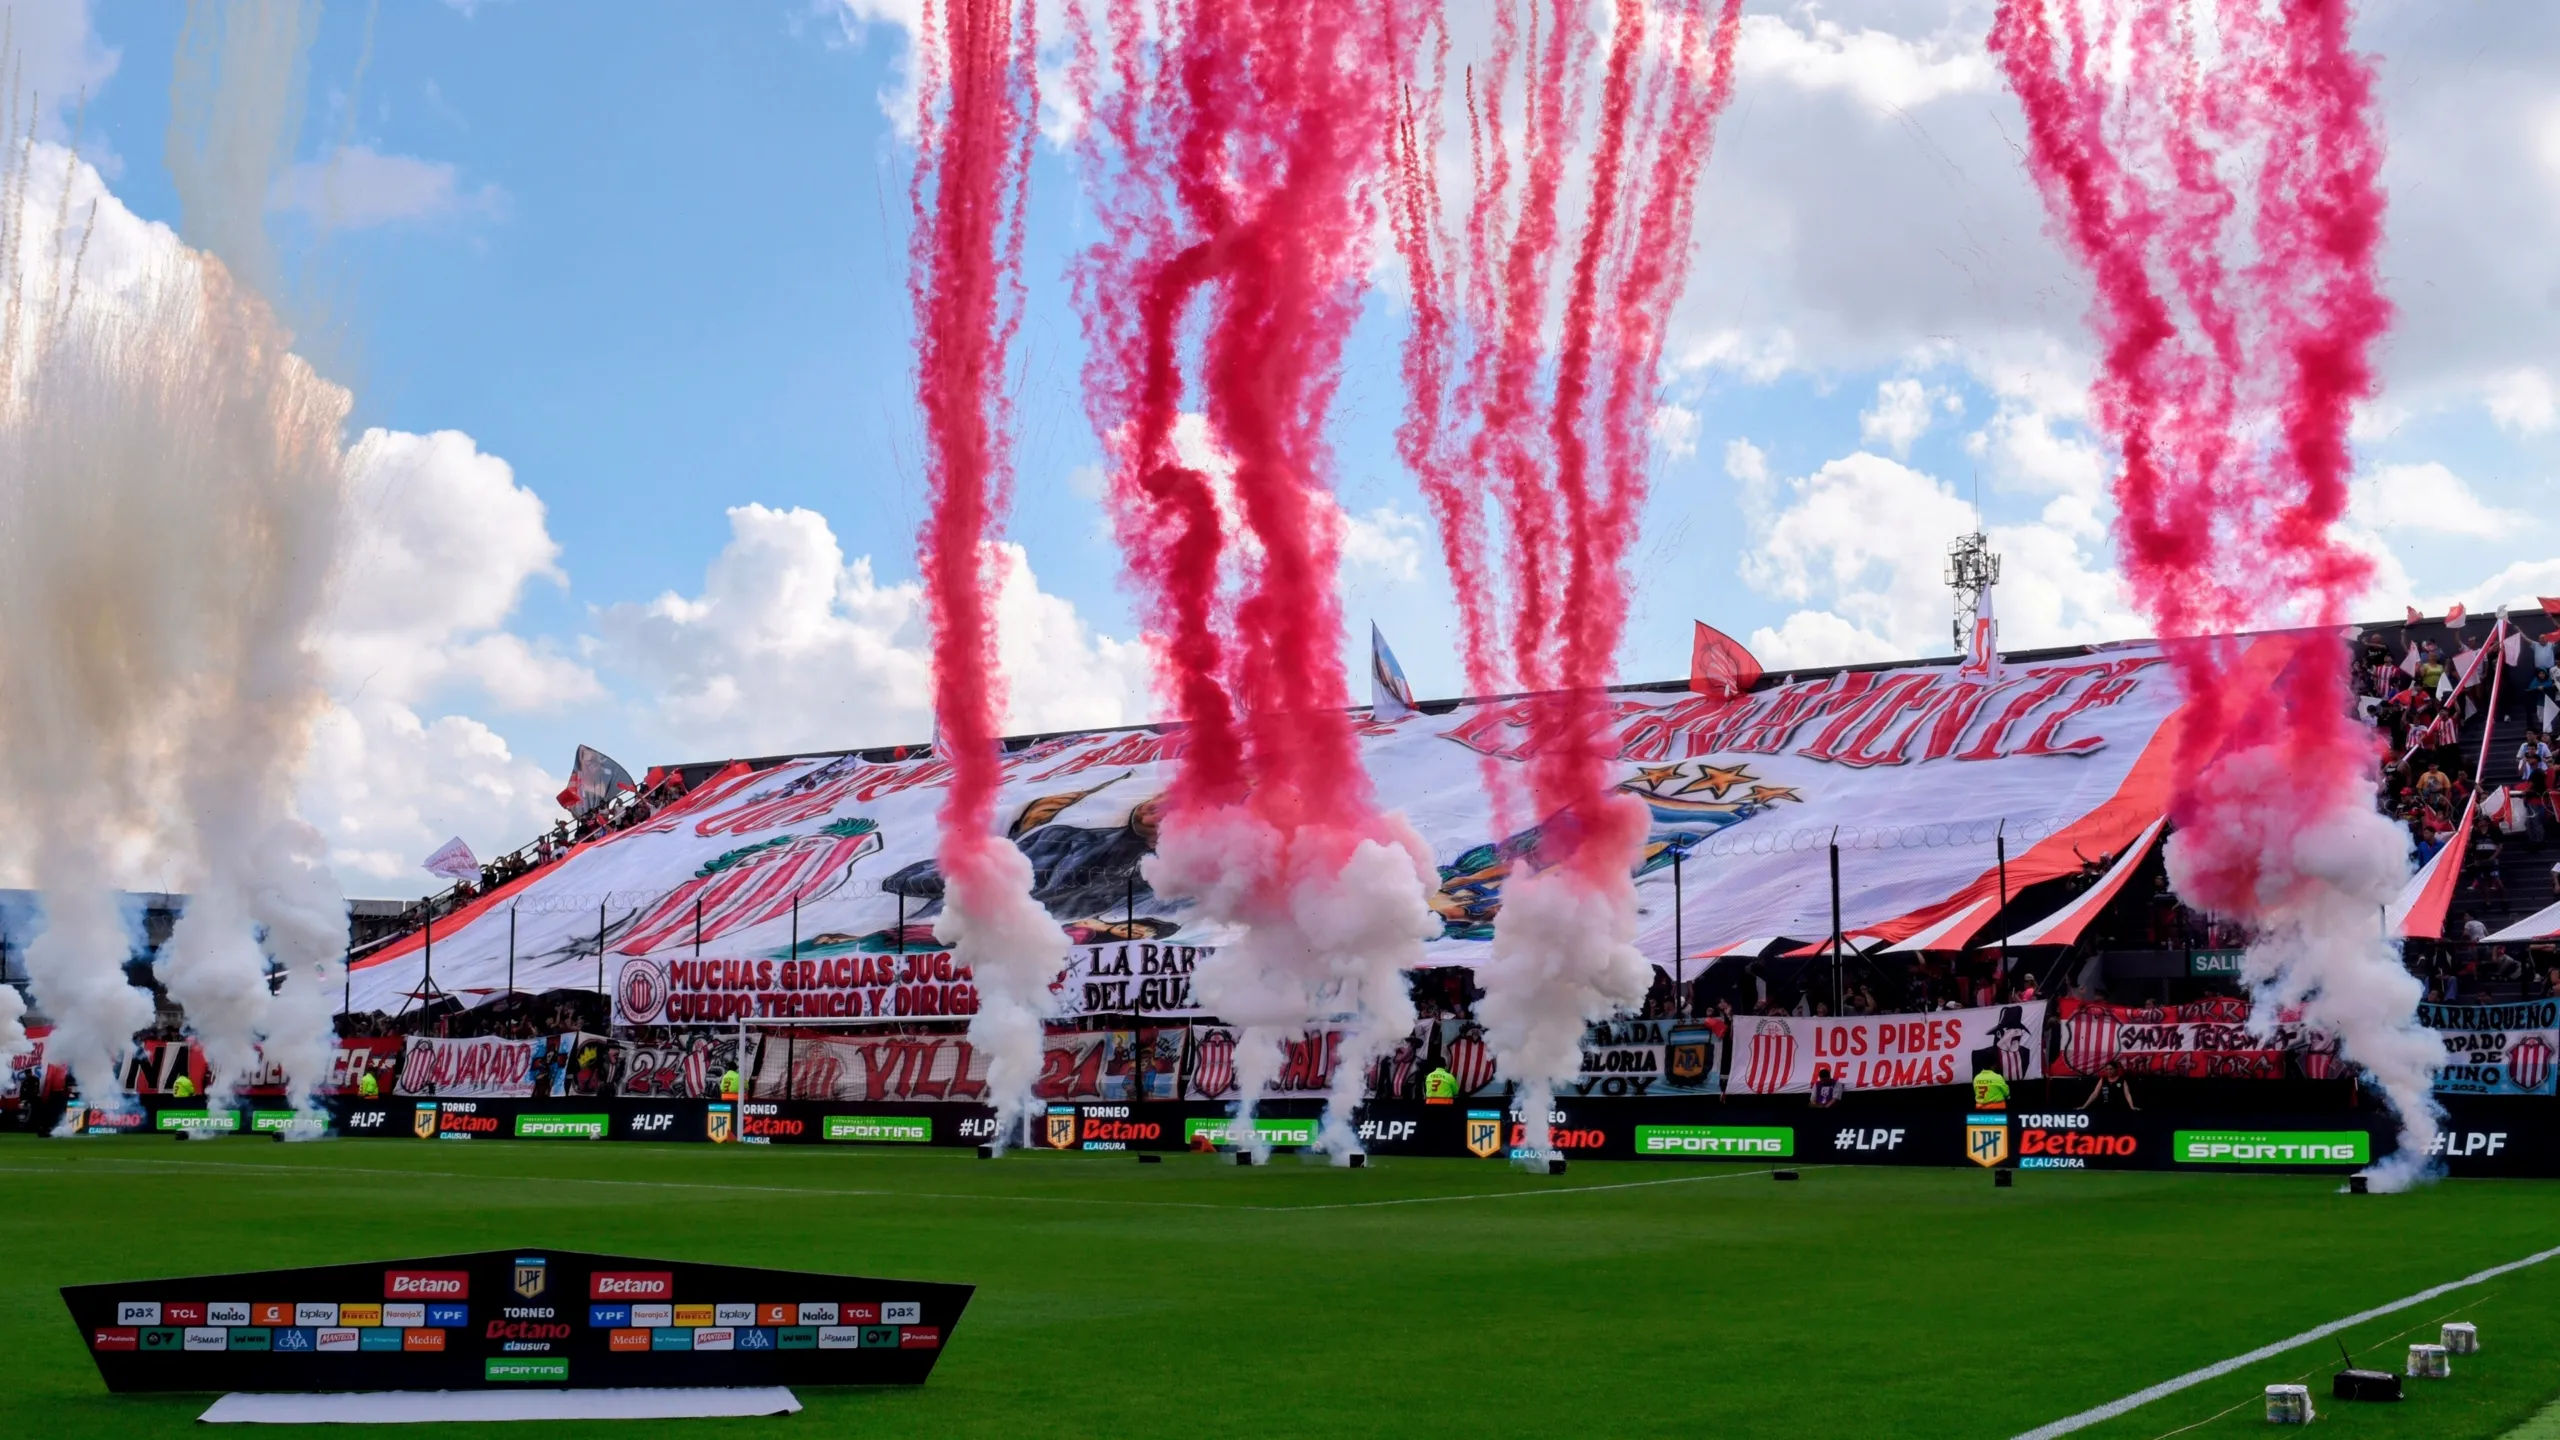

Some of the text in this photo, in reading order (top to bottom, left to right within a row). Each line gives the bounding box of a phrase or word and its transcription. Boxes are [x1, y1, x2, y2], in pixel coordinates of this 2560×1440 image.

[1087, 943, 1215, 976] LA BAR
[669, 951, 972, 991] MUCHAS GRACIAS JUGA
[1083, 981, 1135, 1012] DEL
[665, 993, 752, 1023] CUERPO
[757, 991, 863, 1019] TECNICO
[867, 988, 888, 1017] Y
[1815, 1019, 1962, 1057] LOS PIBES
[2120, 1024, 2184, 1051] SANTA
[2443, 1033, 2507, 1053] RPADO
[1580, 1049, 1657, 1073] GLORIA
[2470, 1052, 2503, 1064] DE
[430, 1043, 532, 1088] ALVARADO
[626, 1050, 681, 1094] 24
[855, 1039, 990, 1100] VILL
[1031, 1041, 1105, 1101] 21
[1855, 1054, 1955, 1089] LOMAS
[2434, 1065, 2500, 1085] TINO
[1576, 1075, 1657, 1096] VOY
[1977, 1086, 1988, 1099] 3
[442, 1103, 477, 1113] TORNEO
[743, 1104, 778, 1115] ORNEO
[1082, 1106, 1130, 1118] TORNEO
[89, 1109, 141, 1127] Betano
[162, 1118, 235, 1127] SPORTING
[256, 1119, 323, 1128] SPORNG
[349, 1112, 386, 1128] #LPF
[440, 1113, 498, 1132] Betano
[631, 1114, 674, 1131] #LPF
[1509, 1110, 1567, 1124] TOEO
[2018, 1114, 2090, 1129] TORNEO
[521, 1123, 602, 1134] SPORTING
[830, 1125, 924, 1139] SPORTING
[1082, 1119, 1161, 1140] Betano
[1357, 1120, 1417, 1141] #LPF
[1193, 1129, 1309, 1142] SPORTING
[1509, 1124, 1606, 1149] Btano
[1833, 1128, 1906, 1150] #LPF
[1083, 1142, 1126, 1150] CLAUSURA
[1647, 1137, 1782, 1152] SPORTING
[2019, 1129, 2138, 1156] Betano
[2424, 1131, 2508, 1156] #LPF
[2187, 1143, 2355, 1160] SPORTING
[2021, 1158, 2086, 1169] CLAUSURA
[392, 1276, 461, 1293] Betano
[598, 1277, 665, 1293] Betano
[124, 1307, 154, 1320] pax
[170, 1309, 198, 1318] TCL
[211, 1309, 246, 1321] Naldo
[300, 1309, 334, 1319] bplay
[341, 1310, 380, 1320] PIRELLI
[432, 1311, 463, 1320] YPF
[503, 1307, 555, 1318] TORNEO
[594, 1311, 625, 1320] YPF
[675, 1311, 712, 1320] PIRELLI
[719, 1309, 751, 1320] bplay
[802, 1309, 835, 1321] Naldo
[847, 1309, 873, 1318] TCL
[887, 1306, 914, 1319] pax
[287, 1330, 303, 1338] LA
[485, 1319, 571, 1339] Betano
[749, 1330, 764, 1338] LA
[279, 1338, 308, 1349] CAJA
[320, 1332, 356, 1345] MANTECOL
[407, 1334, 442, 1344] Medifé
[613, 1335, 648, 1345] Medifé
[698, 1332, 732, 1344] MANTECOL
[741, 1338, 769, 1349] CAJA
[504, 1340, 551, 1351] clausura
[489, 1366, 564, 1374] SPORTING
